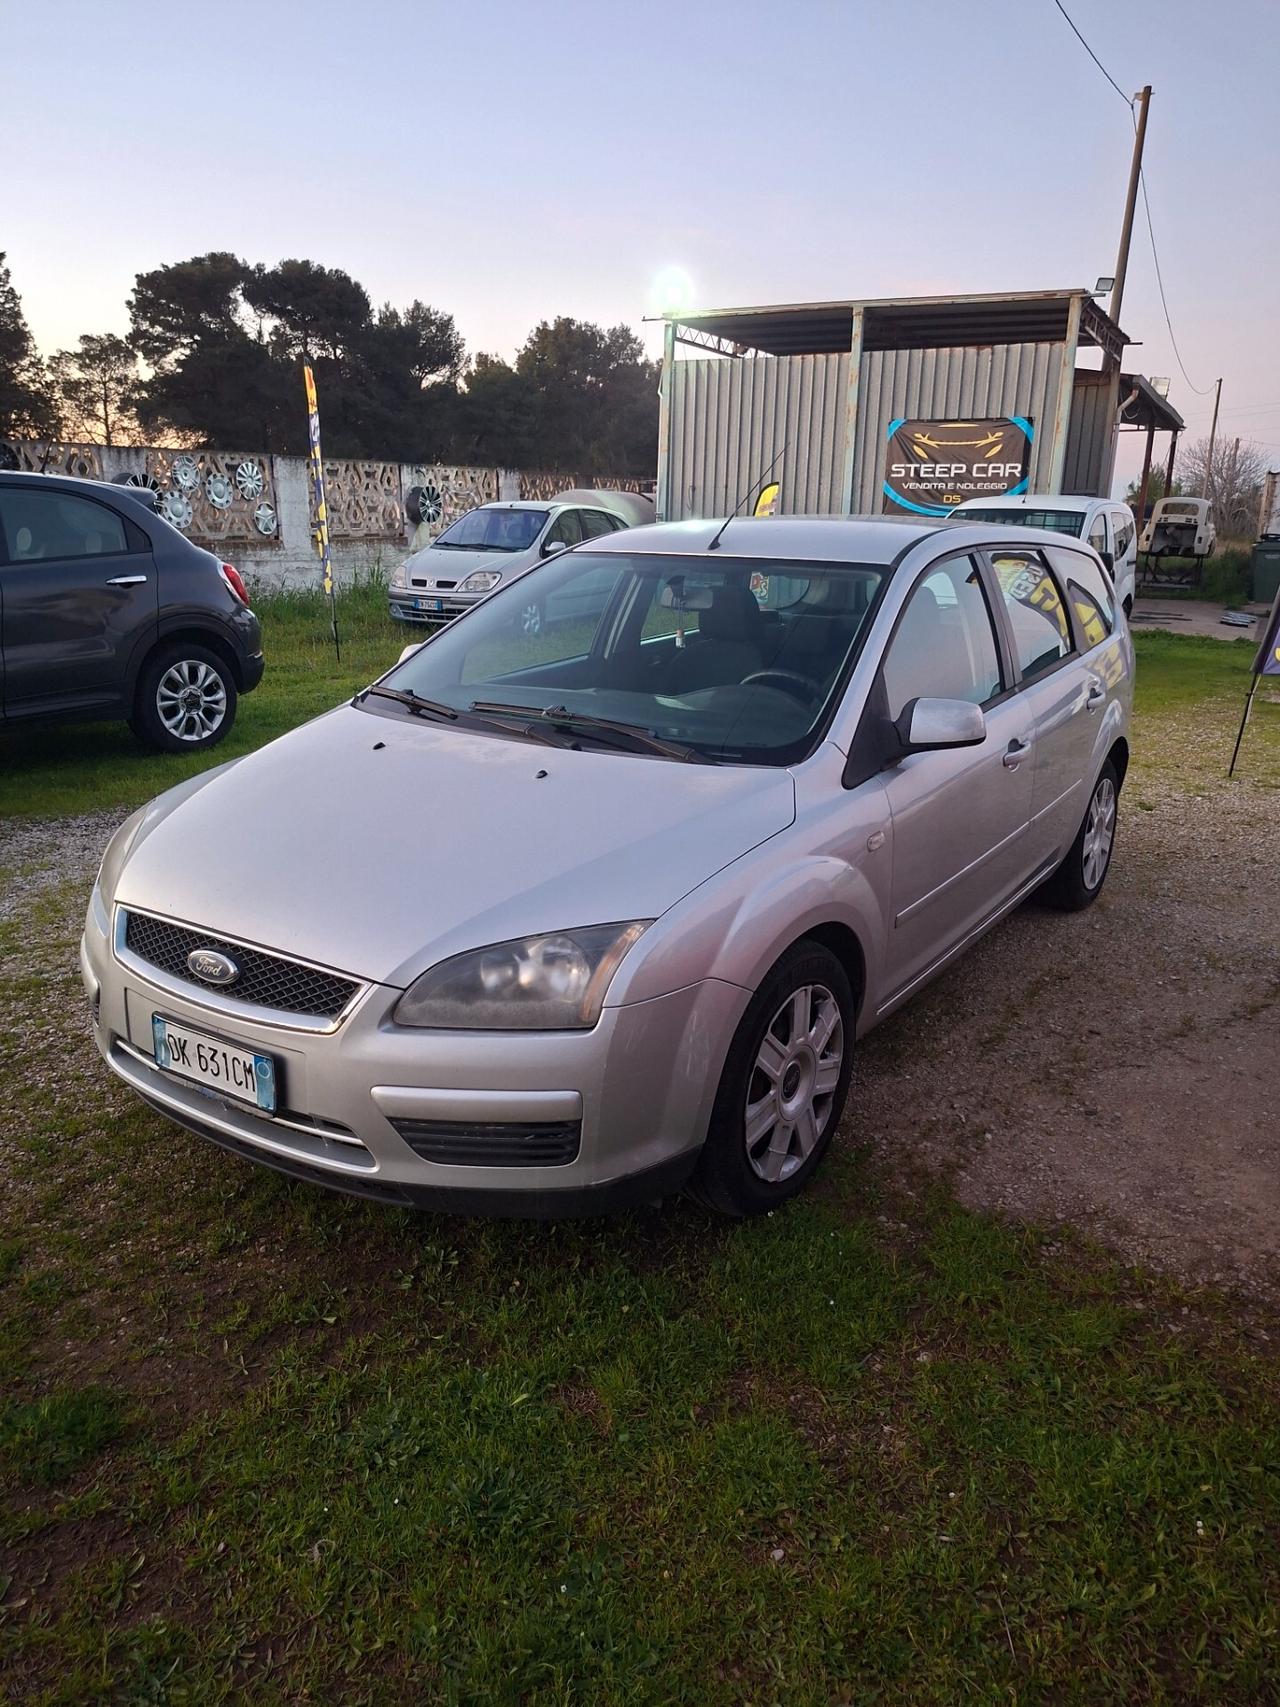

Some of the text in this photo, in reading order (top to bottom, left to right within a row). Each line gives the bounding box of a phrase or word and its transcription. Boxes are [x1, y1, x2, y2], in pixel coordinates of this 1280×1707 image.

[890, 463, 1022, 478] STEEP CAR
[902, 482, 1008, 490] VENDITA E NOLEGGIO
[195, 955, 223, 976] Ford
[167, 1033, 256, 1092] DK 631CM
